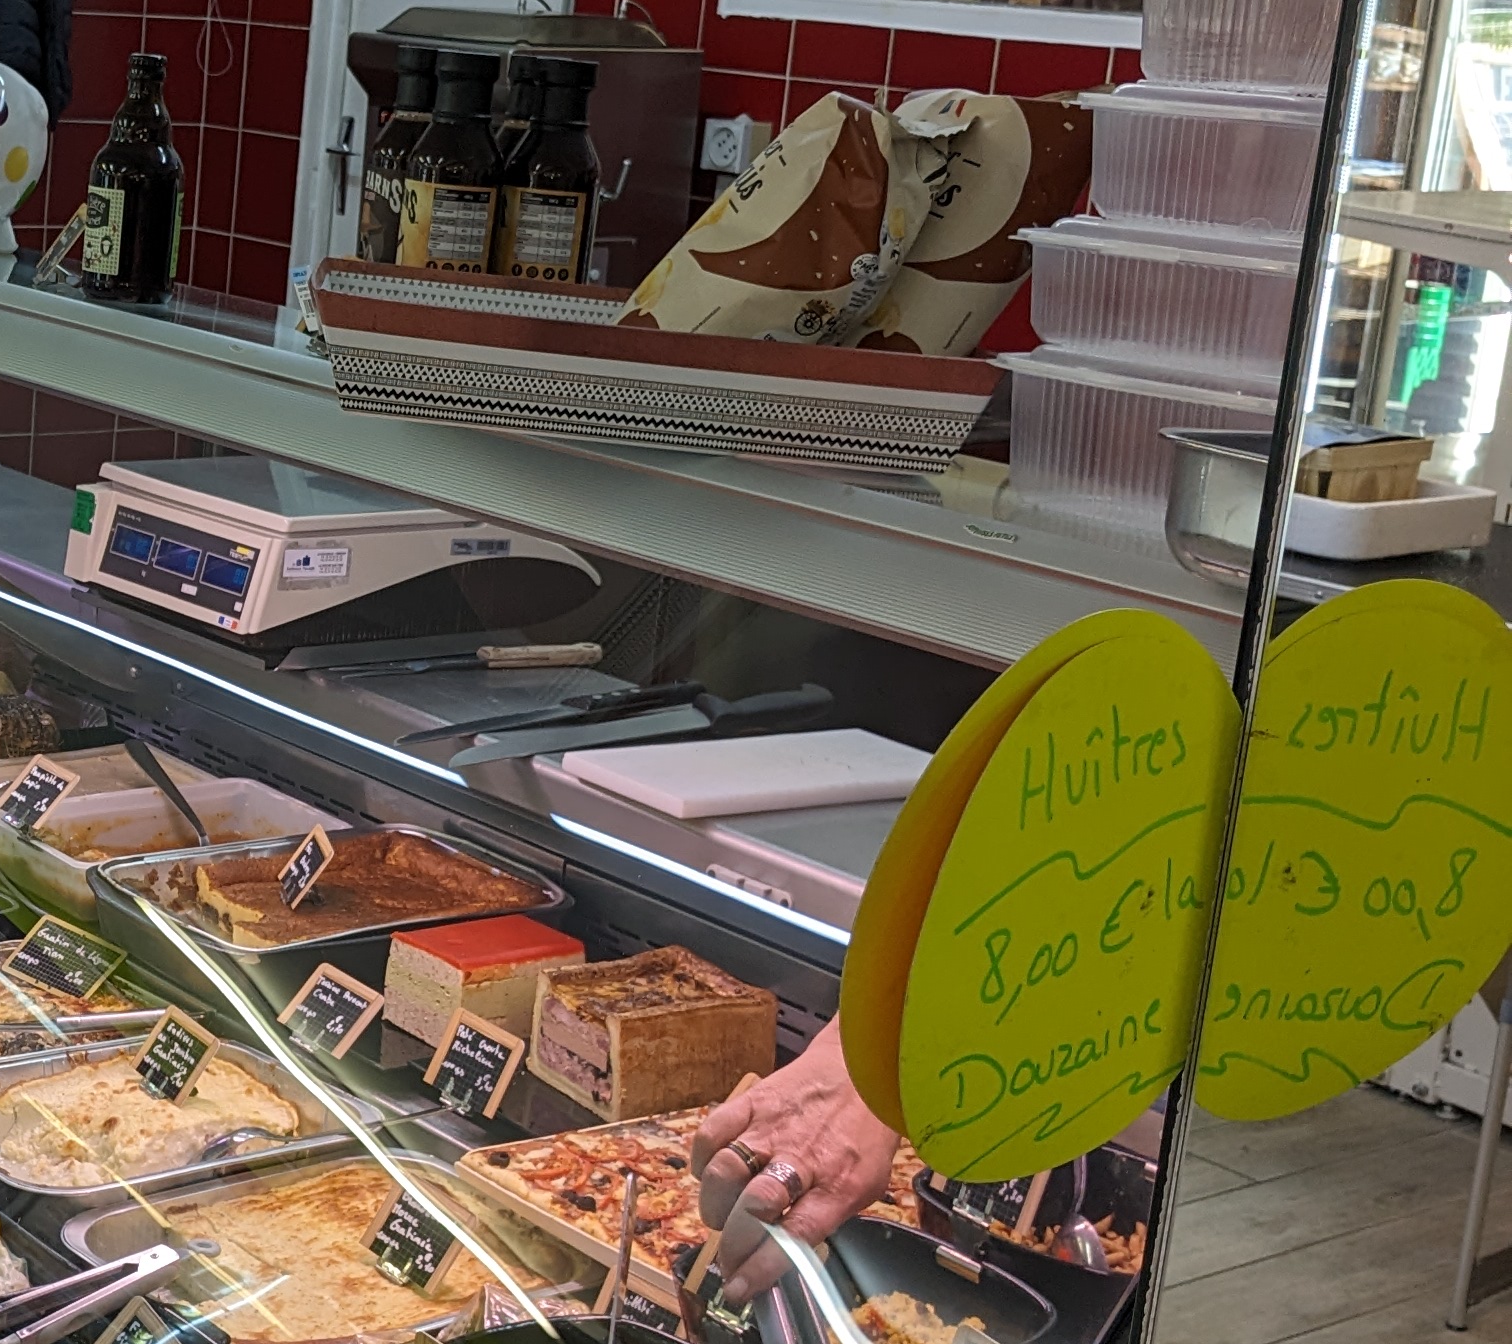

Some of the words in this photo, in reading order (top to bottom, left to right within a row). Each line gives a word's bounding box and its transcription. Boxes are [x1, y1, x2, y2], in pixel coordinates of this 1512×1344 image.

[1020, 703, 1187, 830] Huîtres
[979, 927, 1078, 1025] 8,00
[1098, 878, 1145, 953] €
[1164, 856, 1203, 921] la
[451, 1039, 495, 1069] Richelieu
[937, 998, 1163, 1133] Douzaine
